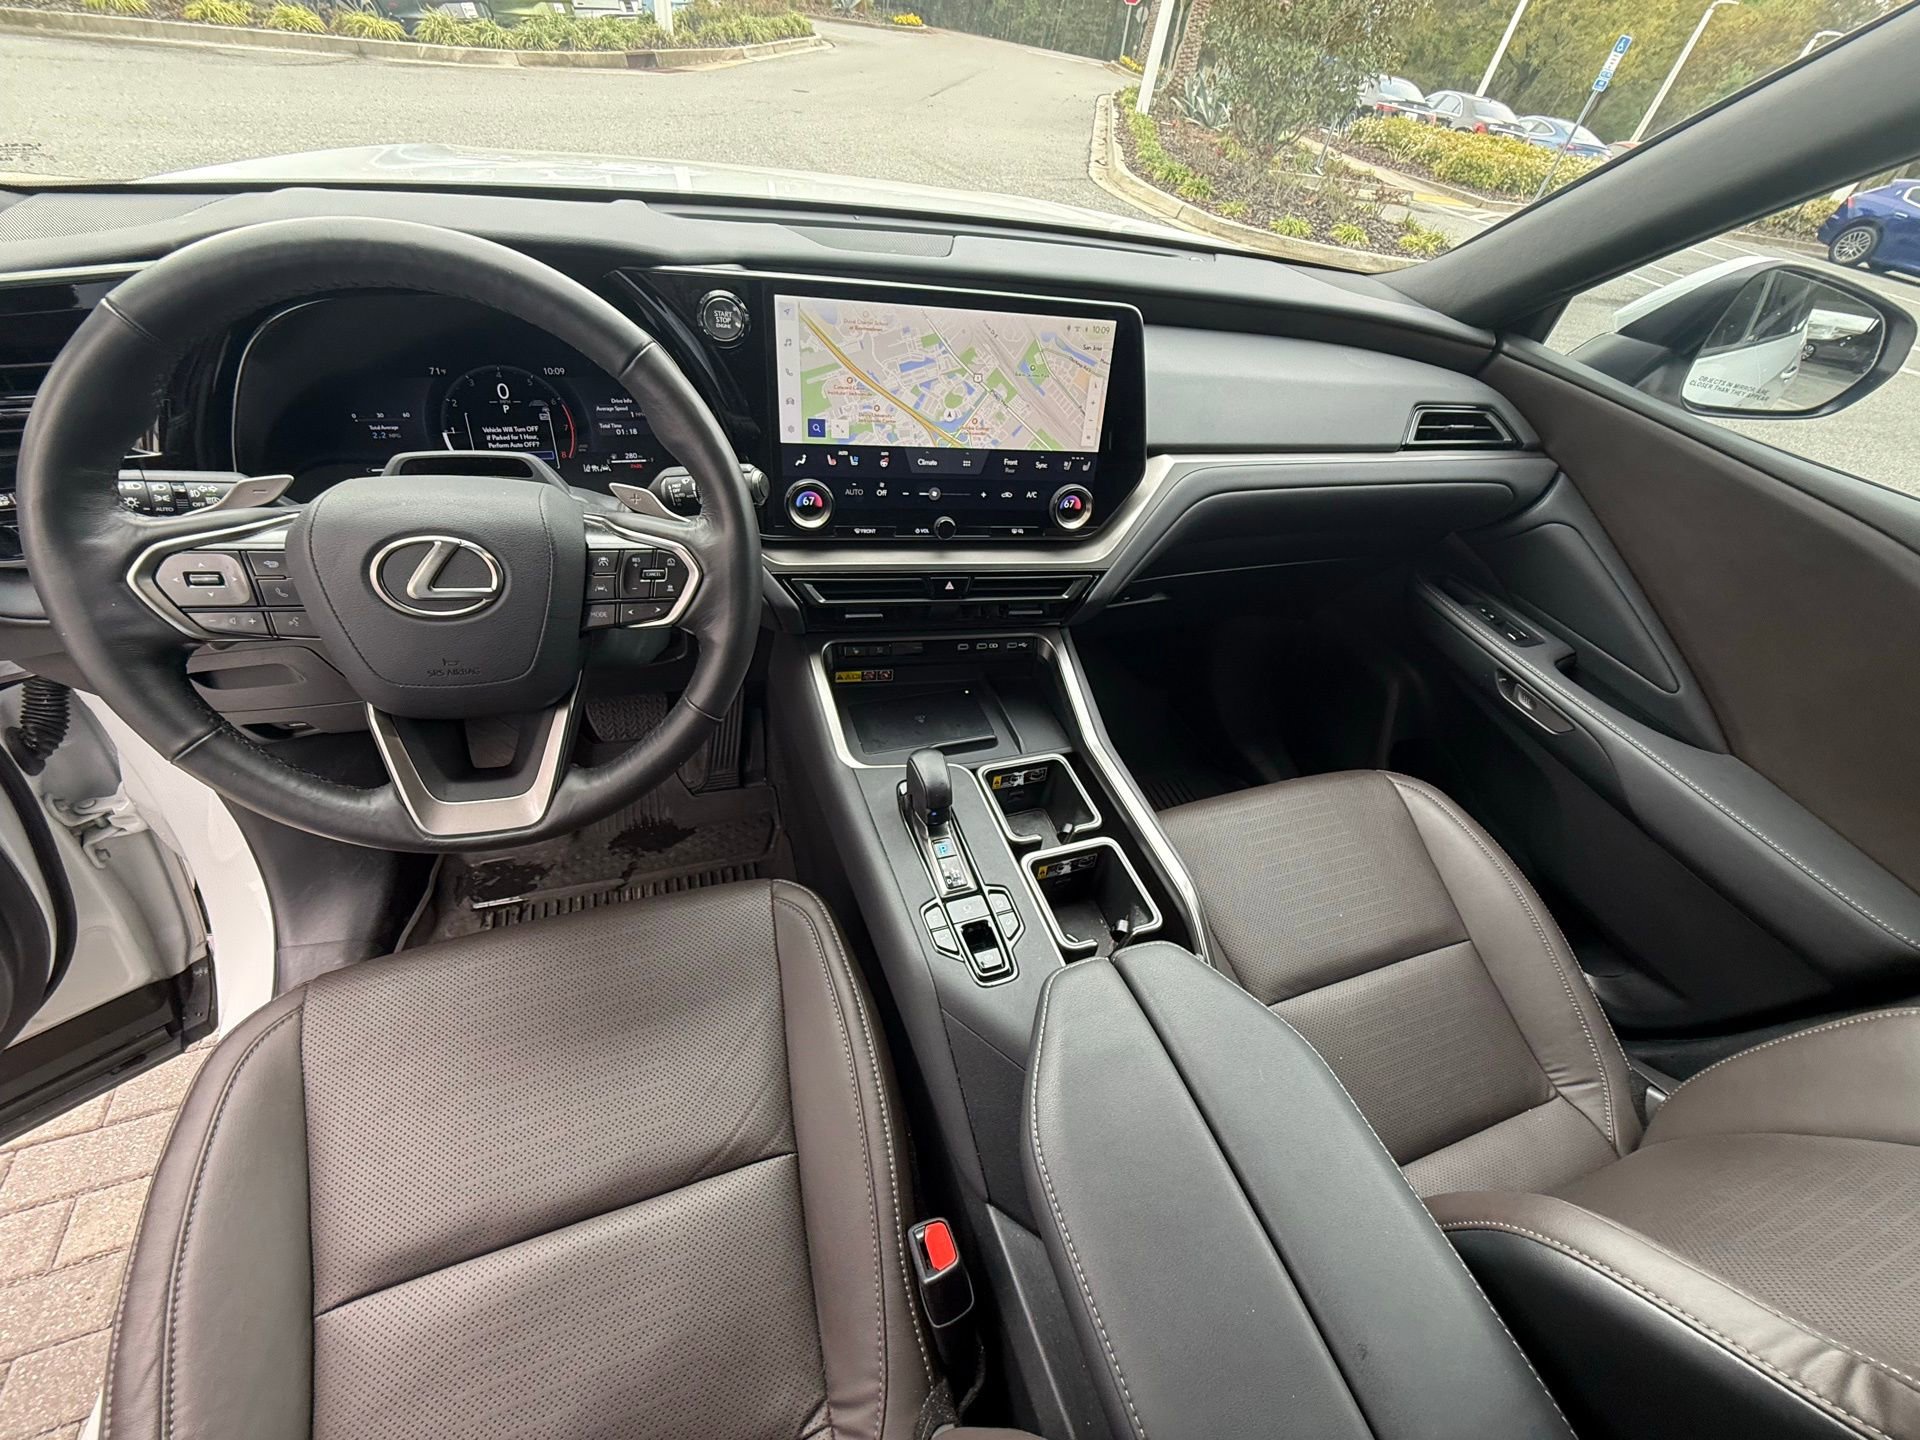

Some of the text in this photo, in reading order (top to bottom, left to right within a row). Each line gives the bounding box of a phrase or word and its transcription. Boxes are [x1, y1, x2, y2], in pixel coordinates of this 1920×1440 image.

[1093, 326, 1110, 334] 10:09
[544, 368, 565, 376] 10:09
[1689, 380, 1714, 389] CLOSER
[1714, 385, 1729, 393] THAN
[1698, 376, 1726, 386] OBJECTS
[1733, 383, 1756, 392] MIRROR
[496, 383, 510, 400] 0
[502, 404, 510, 414] P
[803, 497, 814, 505] 67
[1064, 500, 1074, 508] 67
